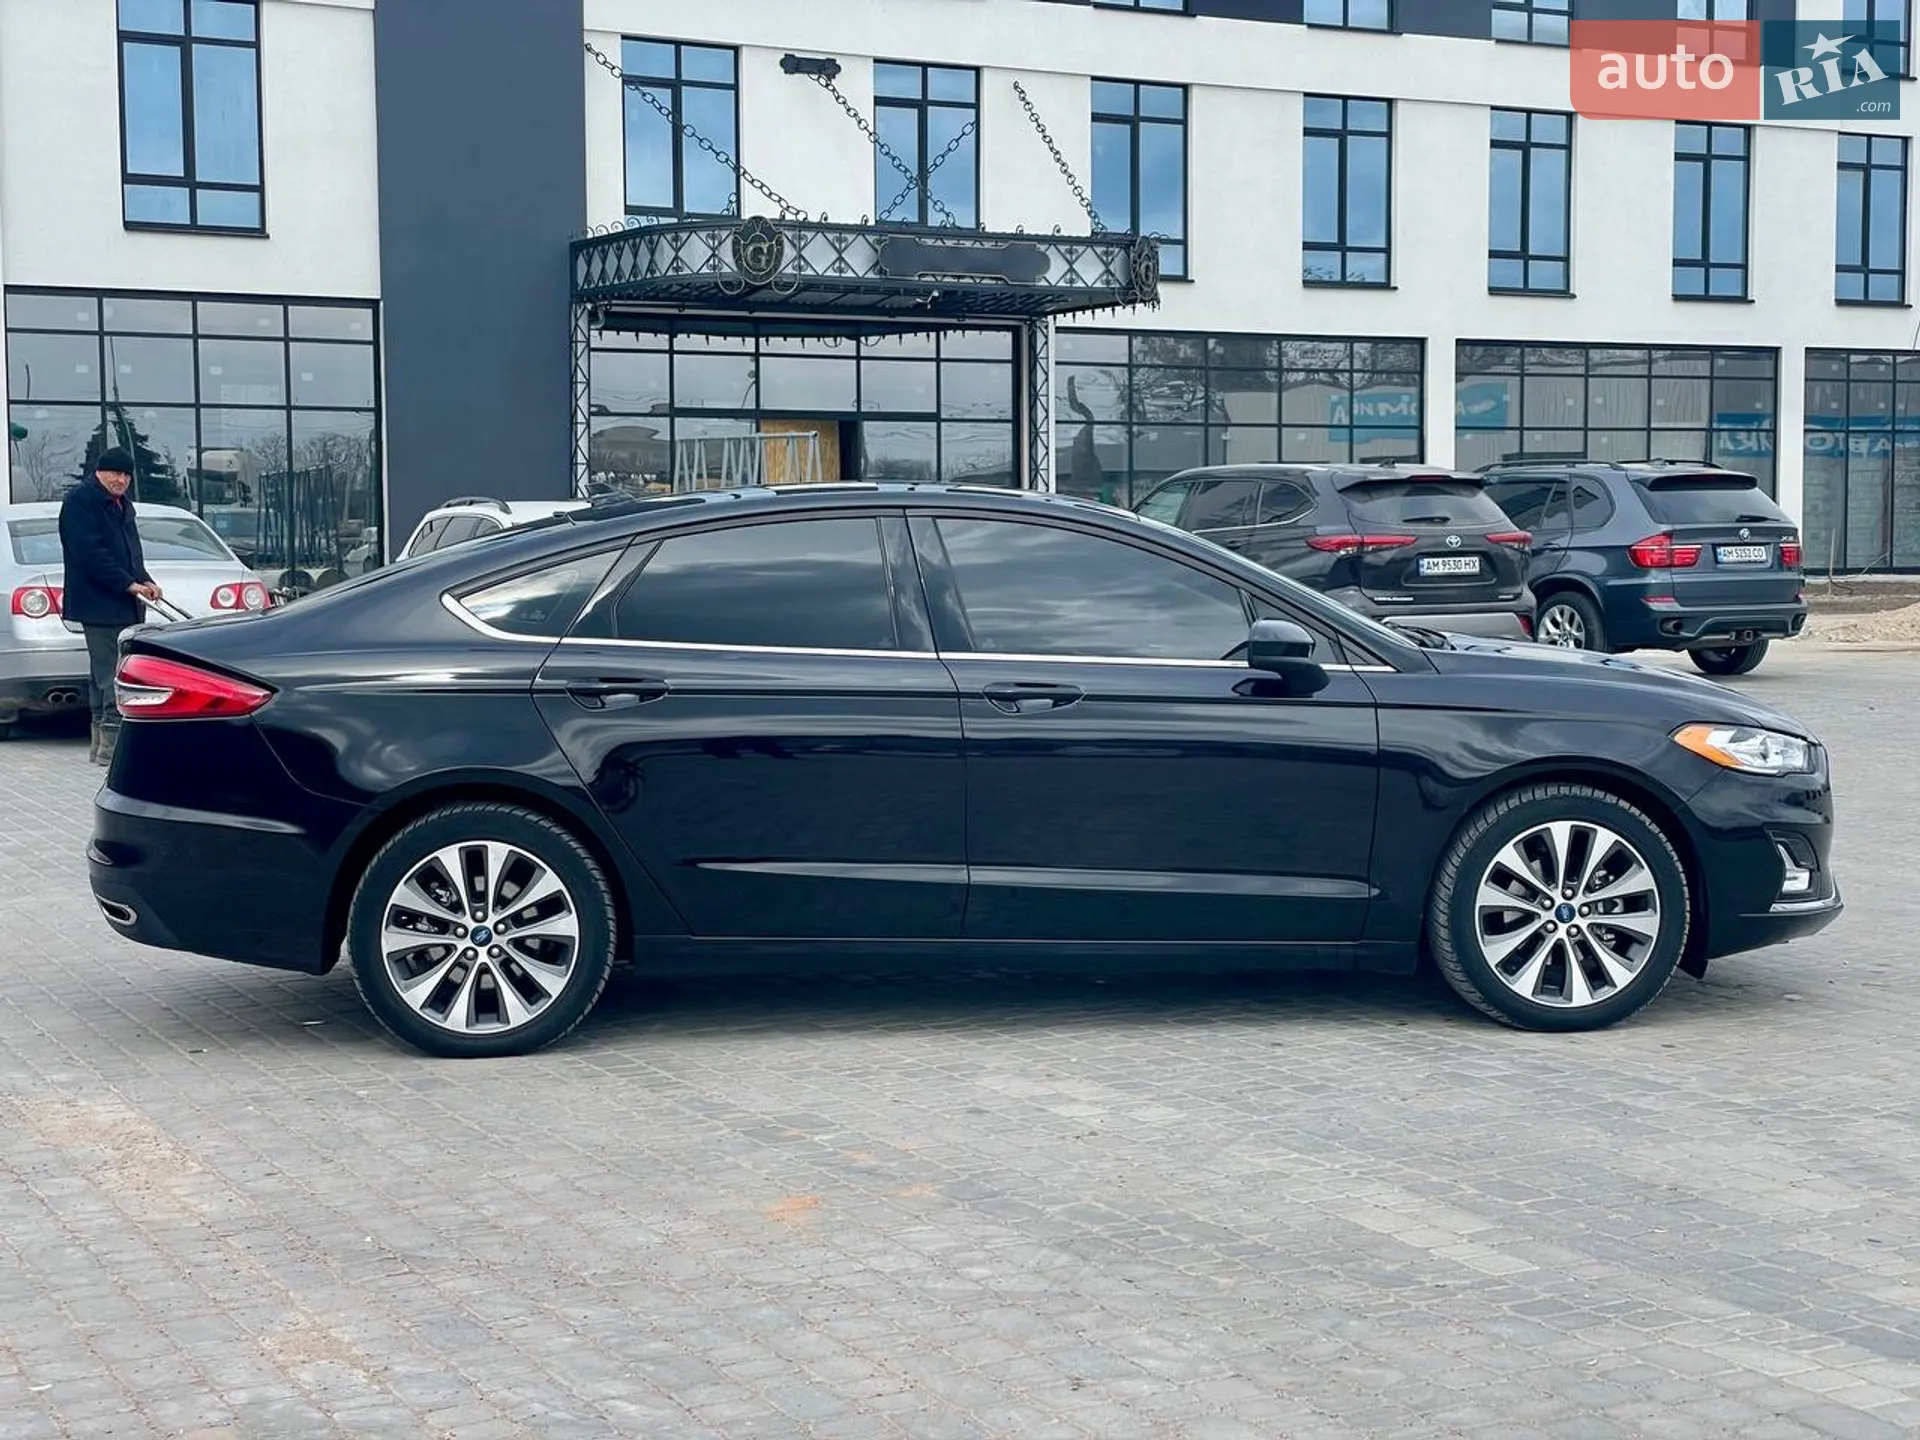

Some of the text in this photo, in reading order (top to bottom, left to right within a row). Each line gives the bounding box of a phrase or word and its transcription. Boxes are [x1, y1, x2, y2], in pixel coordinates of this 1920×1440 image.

[1426, 559, 1477, 571] AM 9530 HX
